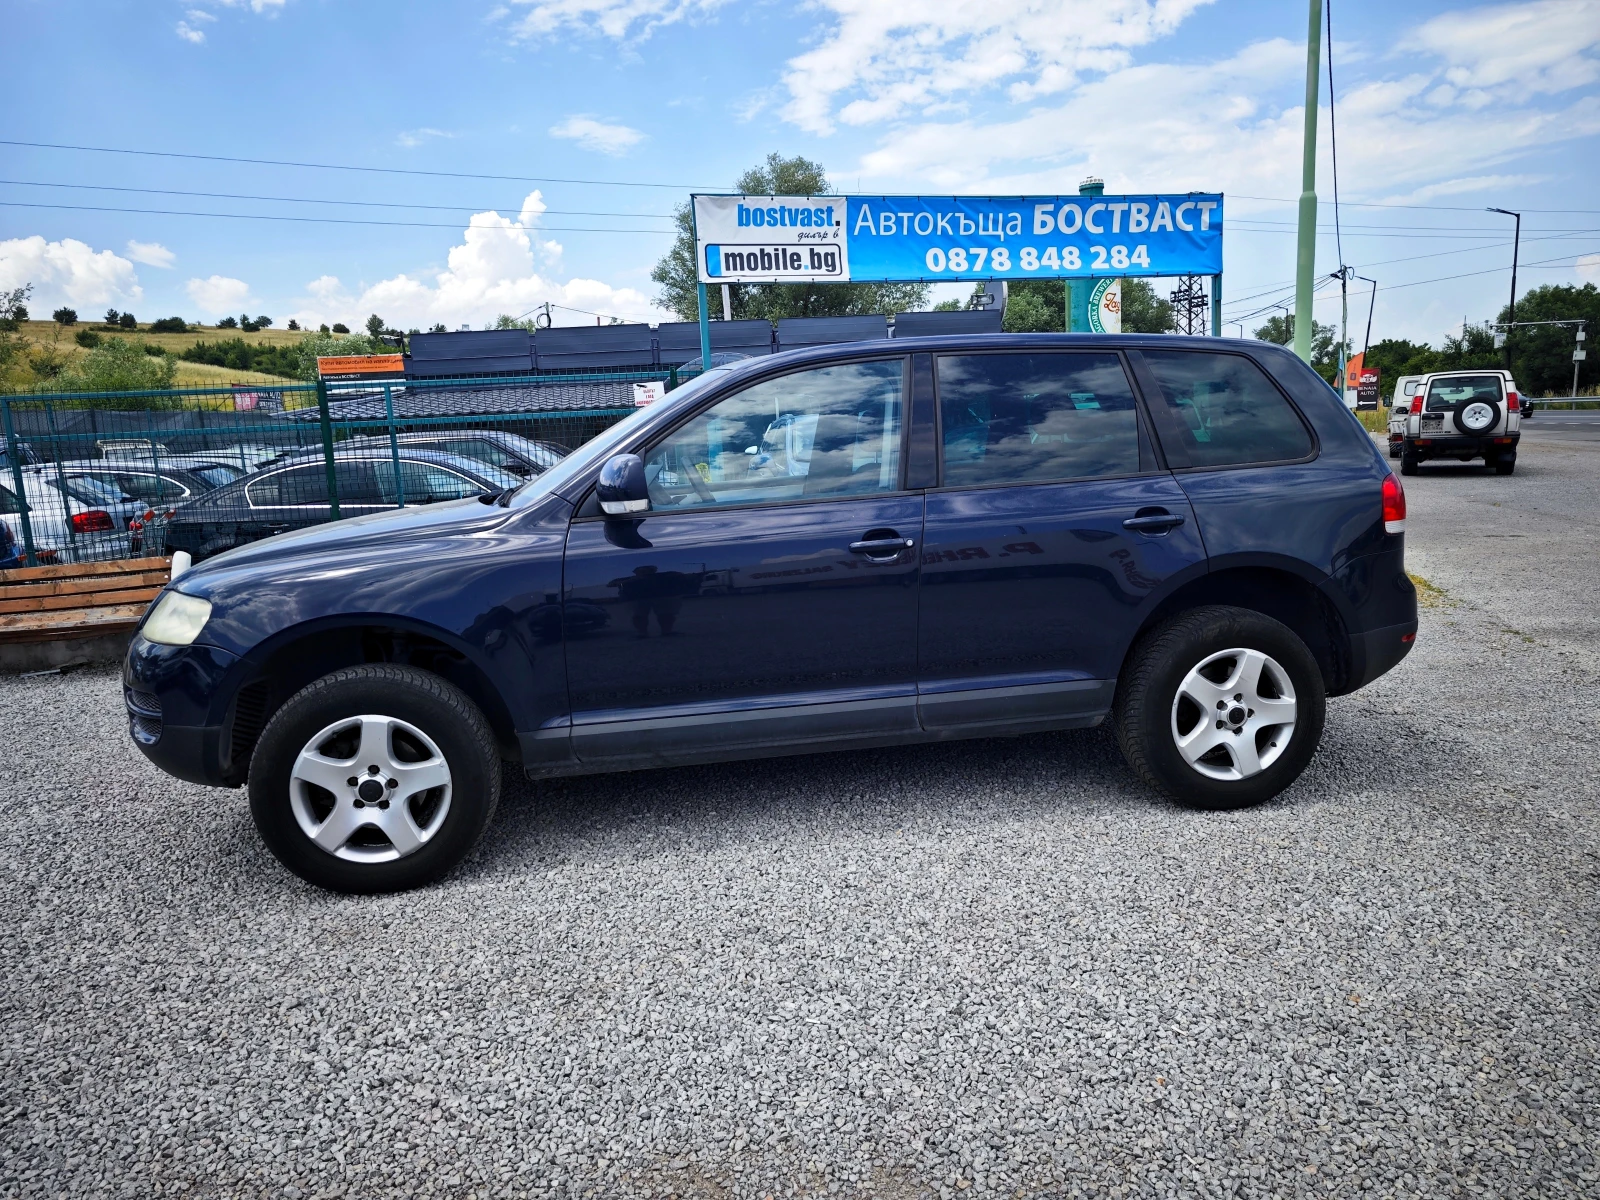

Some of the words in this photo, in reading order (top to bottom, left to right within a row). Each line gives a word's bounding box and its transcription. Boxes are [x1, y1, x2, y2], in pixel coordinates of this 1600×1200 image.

[737, 203, 841, 227] bostvast.
[1033, 201, 1217, 235] БОСТВАСТ
[724, 248, 837, 272] mobile.bg
[925, 247, 1012, 272] 0878
[1019, 246, 1082, 271] 848
[1090, 244, 1151, 269] 284
